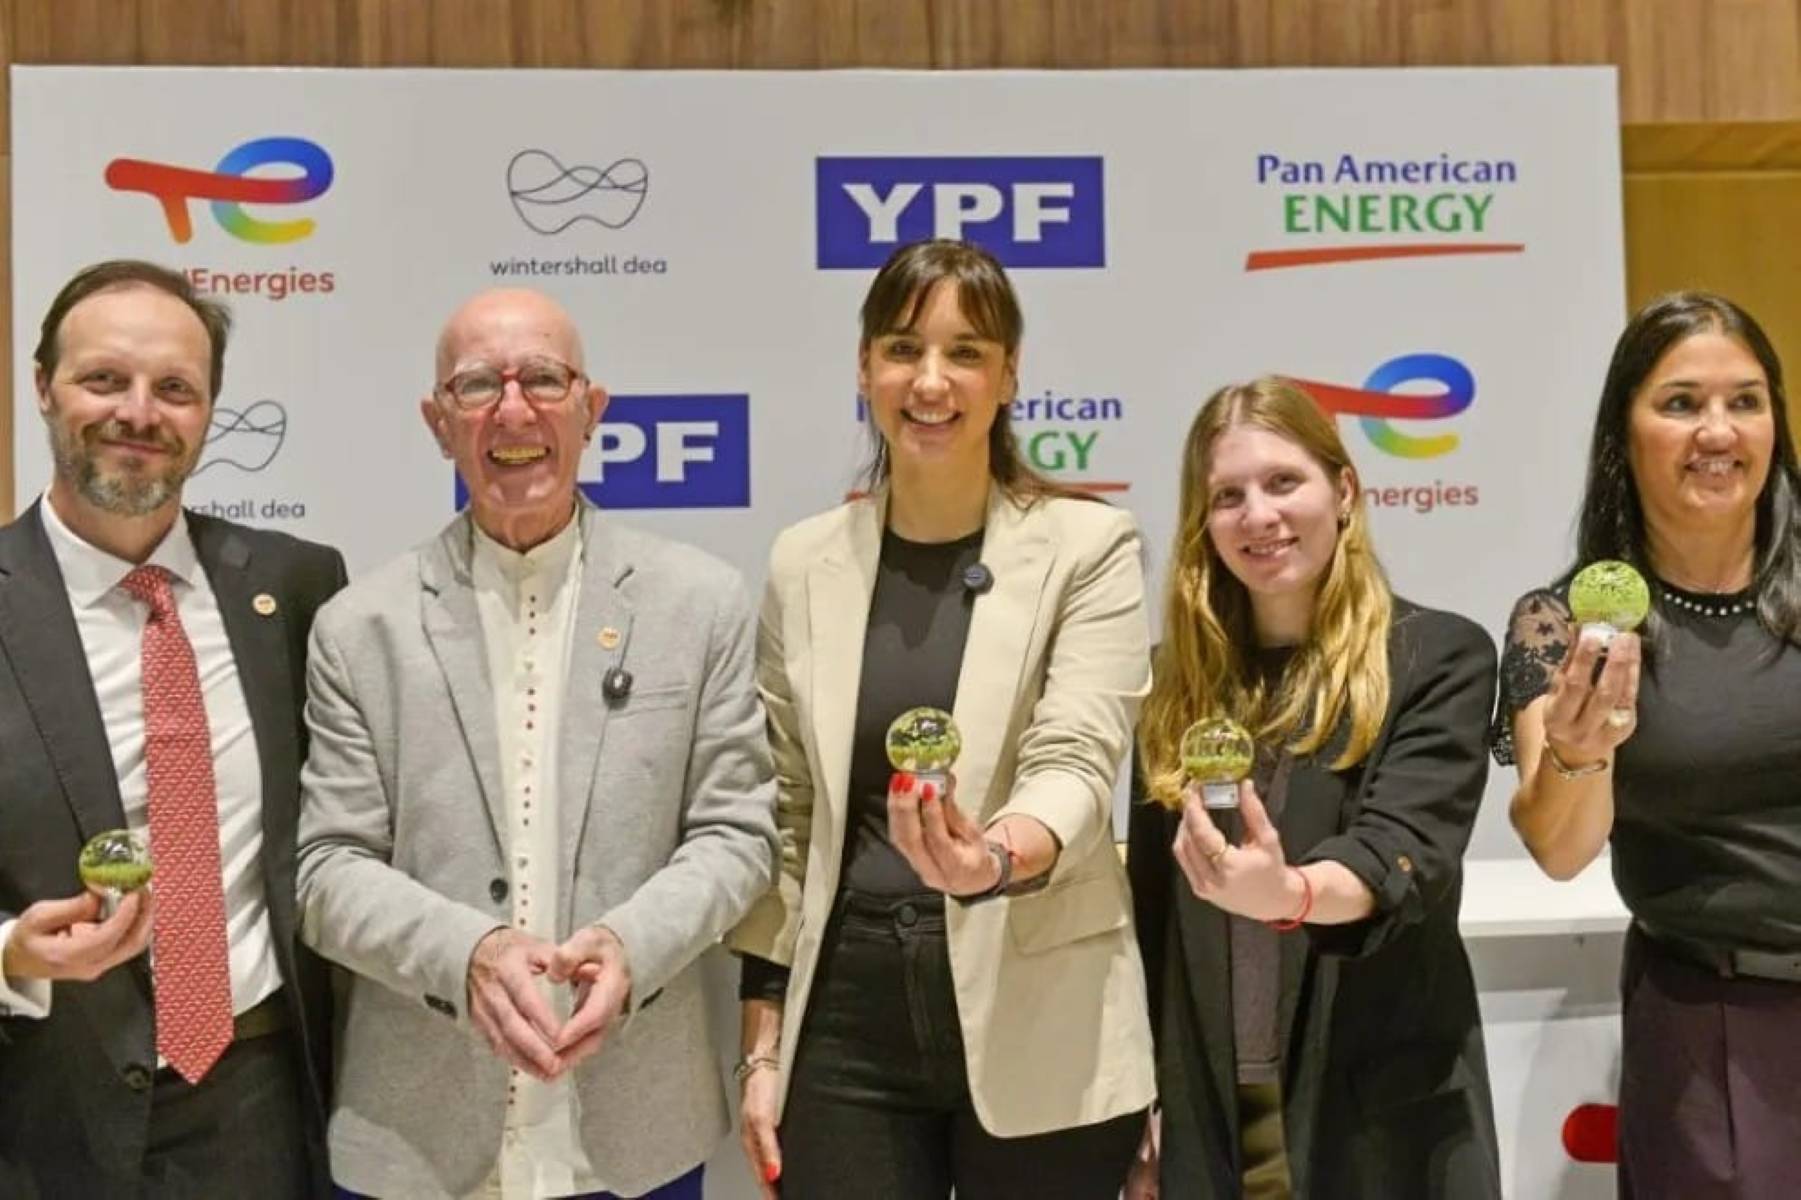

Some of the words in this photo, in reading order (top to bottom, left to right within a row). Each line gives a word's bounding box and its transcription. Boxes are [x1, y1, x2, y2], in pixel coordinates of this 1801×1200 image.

[1258, 154, 1324, 184] Pan
[1335, 153, 1517, 184] American
[844, 183, 1075, 243] YPF
[1284, 194, 1494, 232] ENERGY
[490, 254, 617, 275] wintershall
[623, 255, 668, 274] dea
[183, 267, 335, 301] Energies
[1009, 391, 1123, 422] erican
[577, 421, 719, 483] PF
[261, 499, 305, 519] dea
[1364, 480, 1479, 514] nergies
